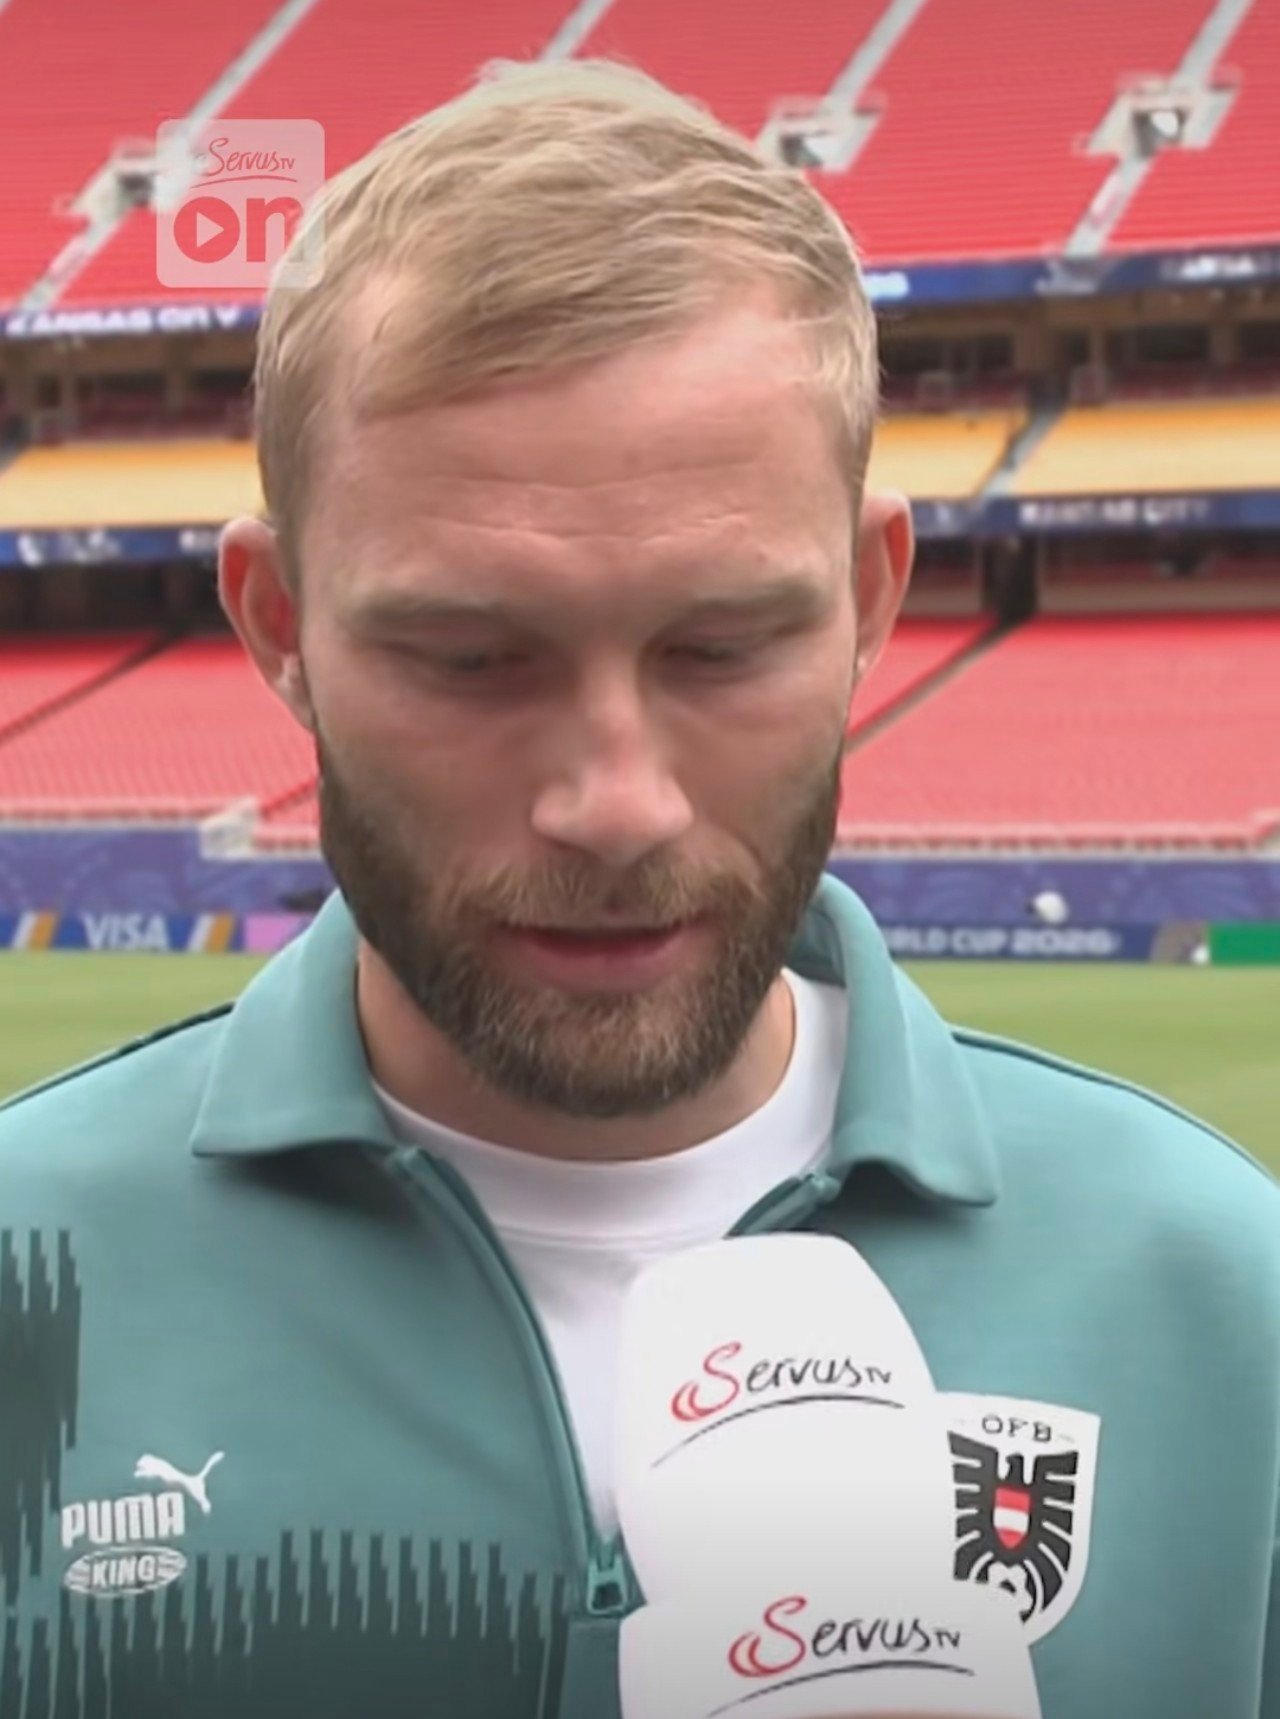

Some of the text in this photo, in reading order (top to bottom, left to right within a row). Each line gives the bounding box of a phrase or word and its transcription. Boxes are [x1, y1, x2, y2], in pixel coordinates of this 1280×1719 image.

[80, 912, 170, 950] VISA
[951, 926, 1007, 954] CUP
[61, 1491, 185, 1549] PUMA
[92, 1554, 157, 1588] KING
